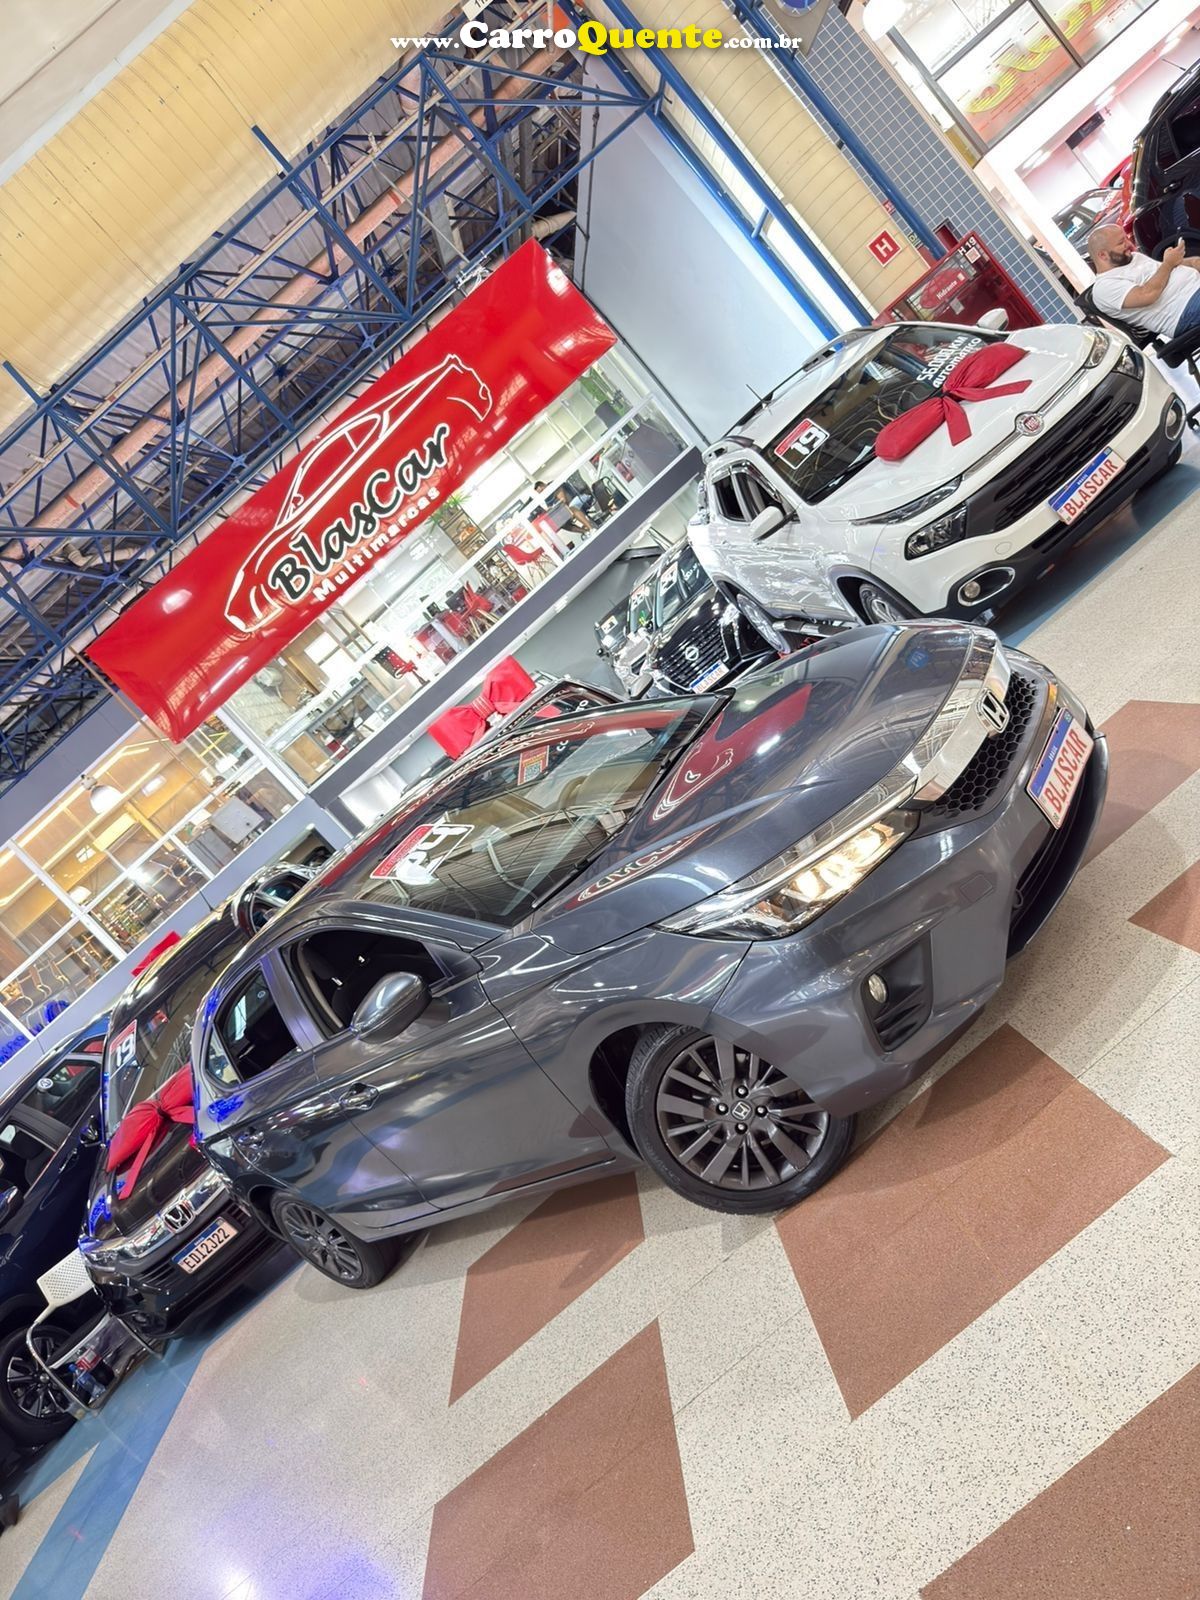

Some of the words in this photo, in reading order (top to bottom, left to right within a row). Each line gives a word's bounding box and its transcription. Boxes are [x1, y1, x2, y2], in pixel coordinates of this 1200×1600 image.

[877, 239, 893, 257] H
[935, 279, 958, 300] Hidrante
[790, 426, 826, 454] 19
[1063, 458, 1118, 516] BLASCAR
[269, 423, 450, 601] BlasCar
[1043, 728, 1088, 813] BLASCAR
[116, 1034, 134, 1066] 19
[183, 1226, 230, 1268] EDI2J22
